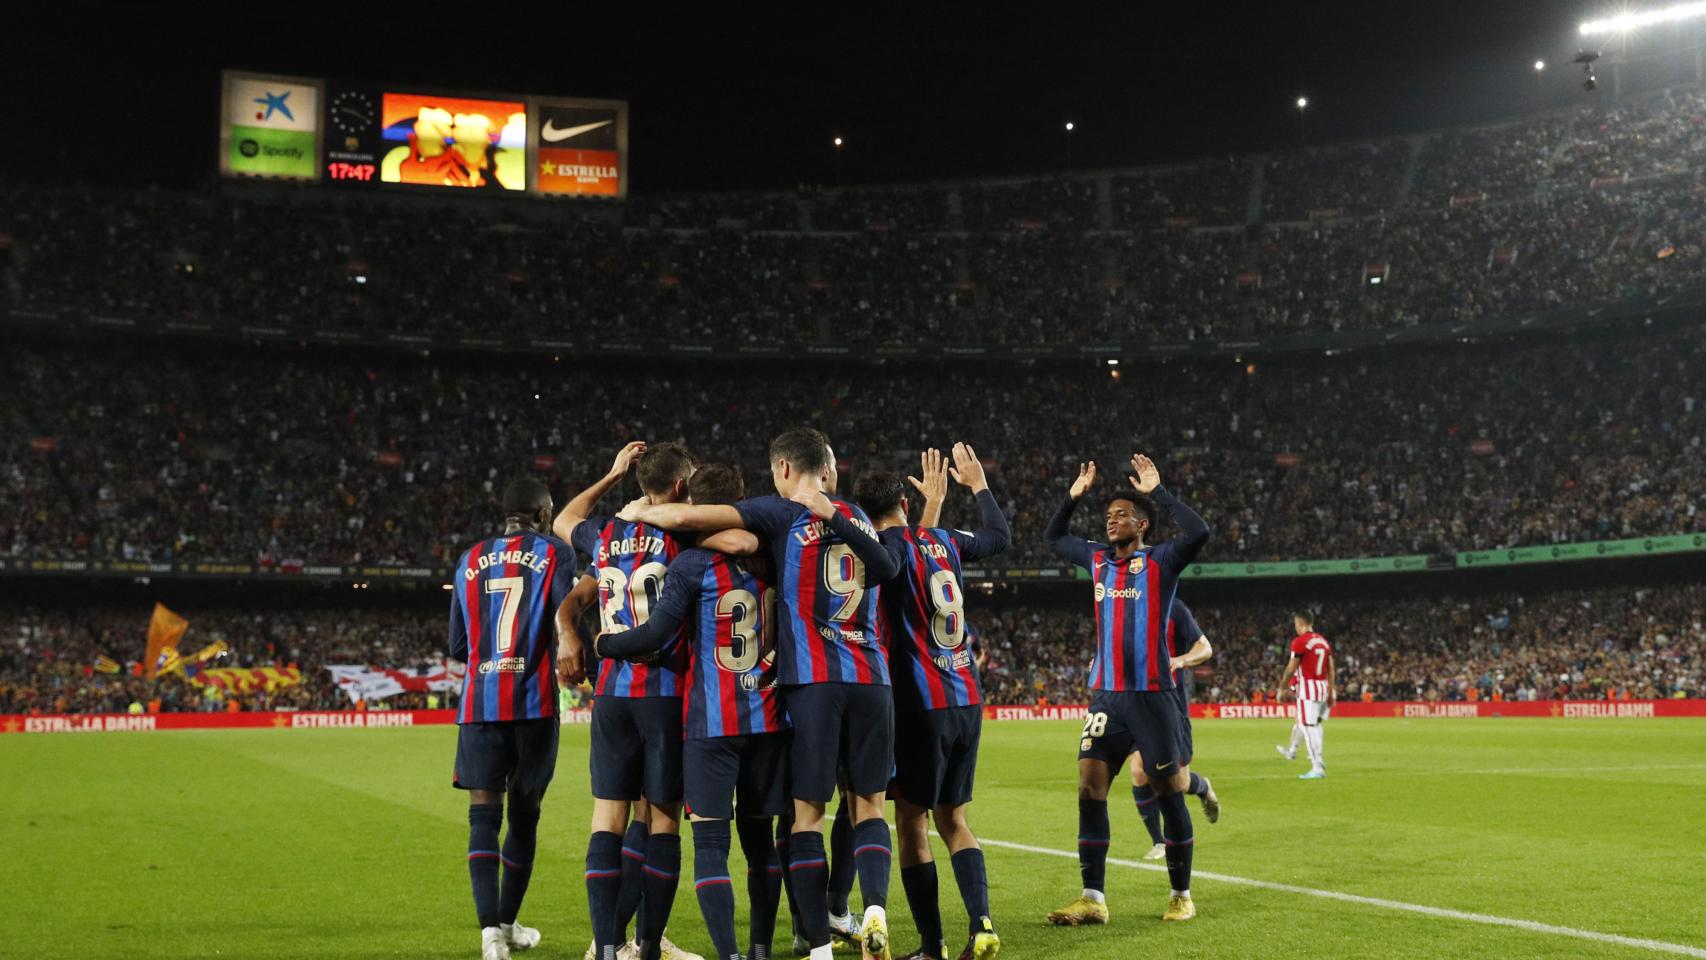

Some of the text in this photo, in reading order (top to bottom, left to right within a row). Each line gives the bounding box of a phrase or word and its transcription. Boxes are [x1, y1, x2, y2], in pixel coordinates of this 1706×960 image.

[328, 162, 375, 180] 17:47
[558, 164, 618, 178] ESTRELLA
[464, 550, 550, 582] O. DEMBÉLÉ
[823, 543, 866, 623] 9
[1106, 587, 1142, 601] Spotify
[598, 561, 668, 635] 20
[484, 576, 524, 654] 7
[929, 569, 965, 650] 8
[1314, 648, 1326, 677] 7
[292, 712, 413, 728] ESTRELLA DAMM
[1060, 707, 1089, 720] DAM
[1563, 703, 1654, 718] ESTRELLA DAMM
[105, 716, 156, 731] DAMM
[1081, 711, 1108, 738] 28
